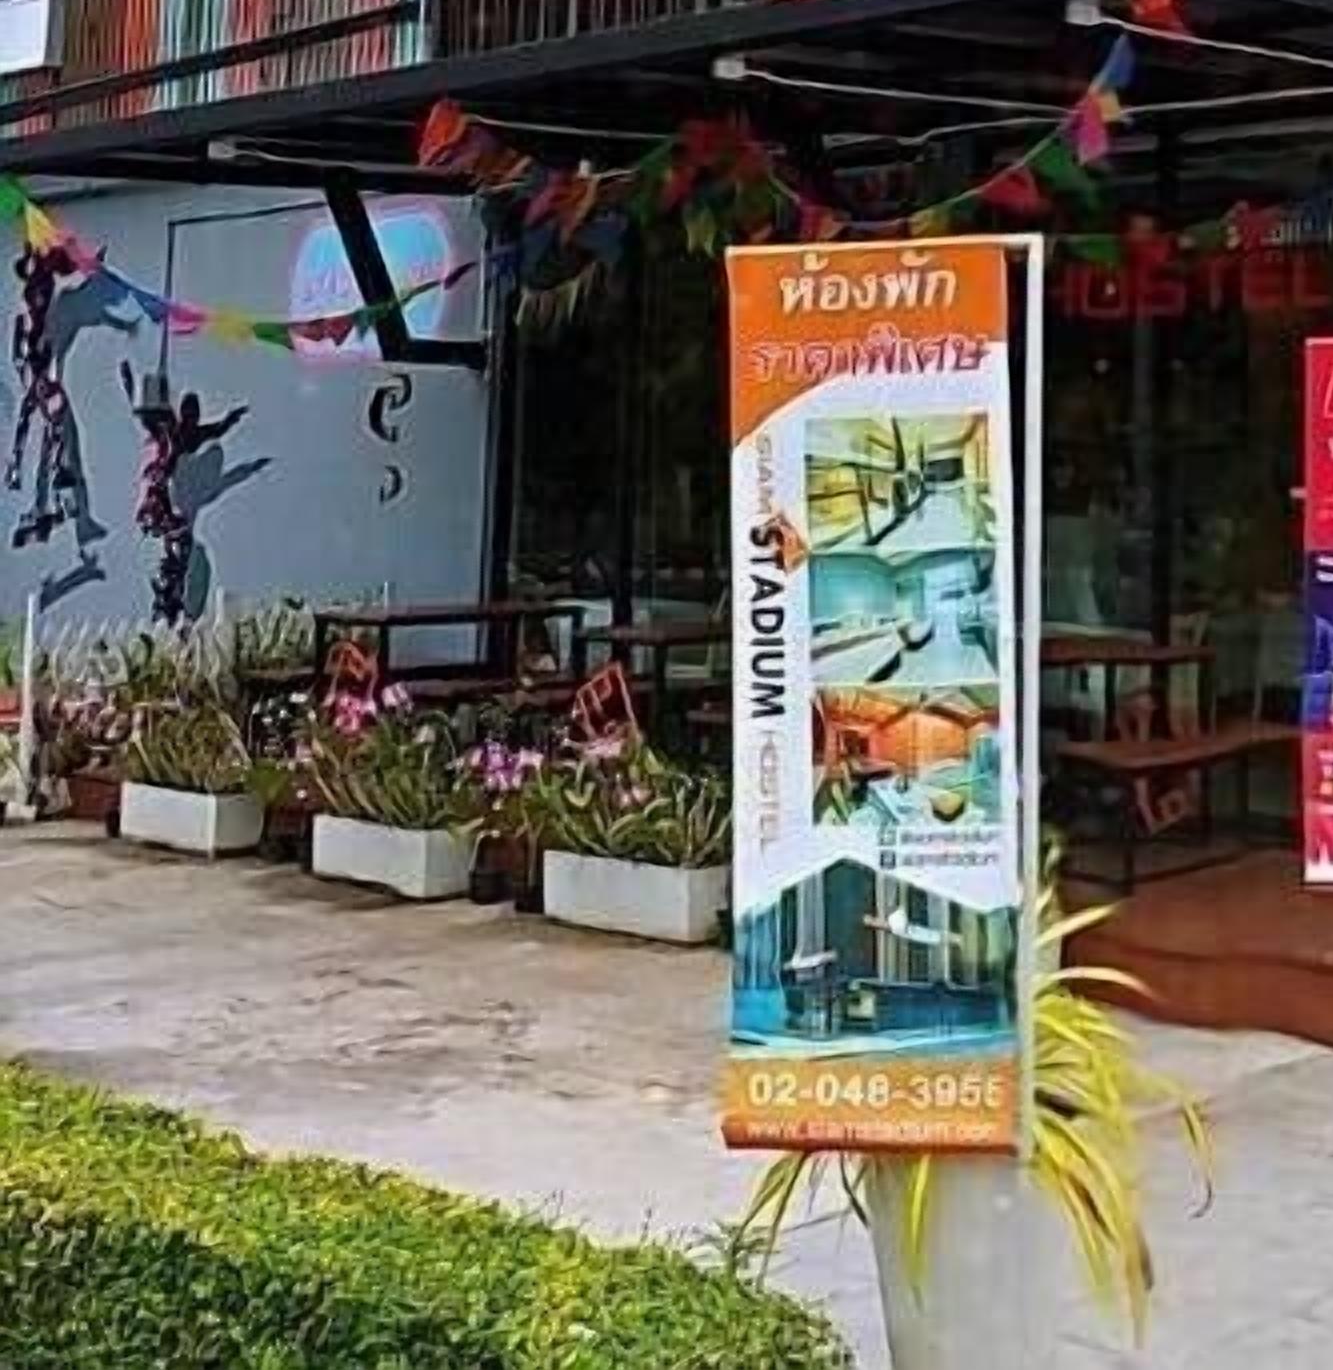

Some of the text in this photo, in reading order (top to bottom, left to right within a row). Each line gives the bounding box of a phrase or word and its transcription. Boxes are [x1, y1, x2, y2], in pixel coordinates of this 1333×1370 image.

[778, 251, 958, 315] ห้องพัก
[748, 526, 786, 720] STADIUM
